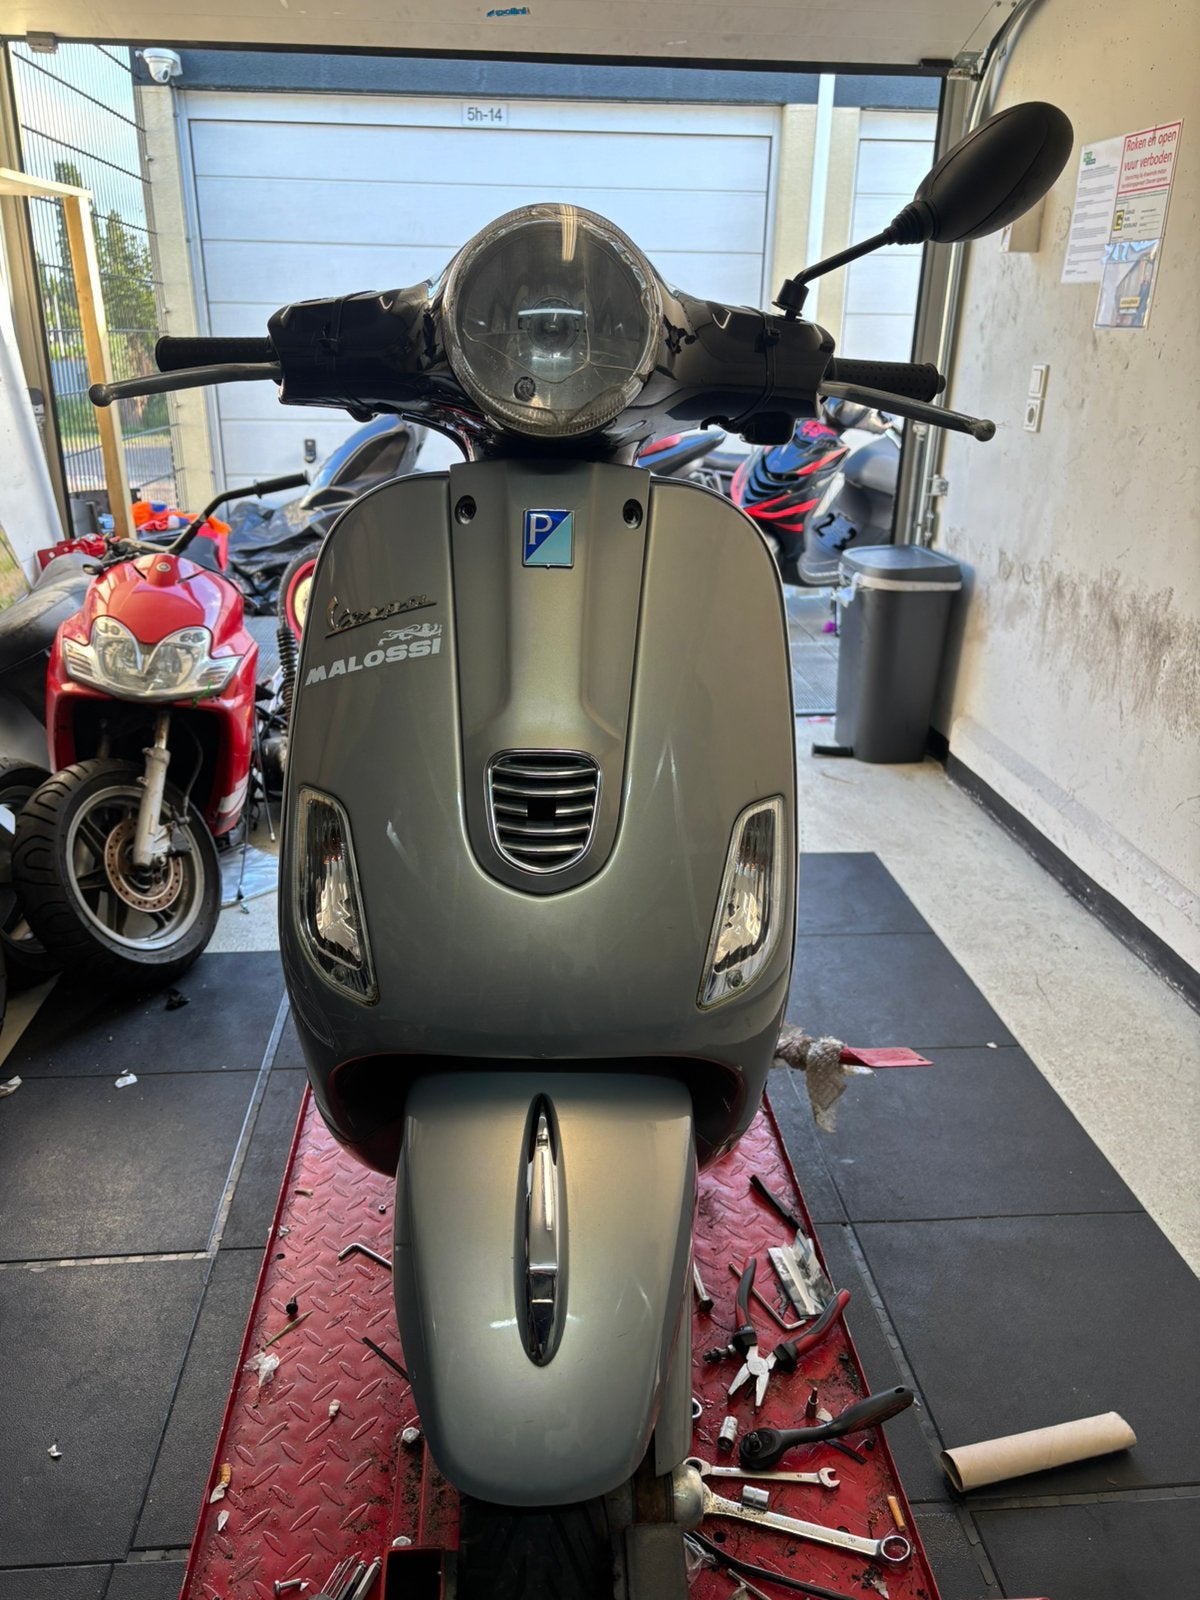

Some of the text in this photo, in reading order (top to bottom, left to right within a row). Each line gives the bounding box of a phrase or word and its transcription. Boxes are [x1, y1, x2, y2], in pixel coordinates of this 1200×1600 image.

[467, 107, 503, 121] 5h-14
[1126, 131, 1176, 152] Roken en open
[1124, 150, 1172, 171] vuur verboden
[528, 513, 553, 545] P
[305, 638, 442, 687] MALOSSI
